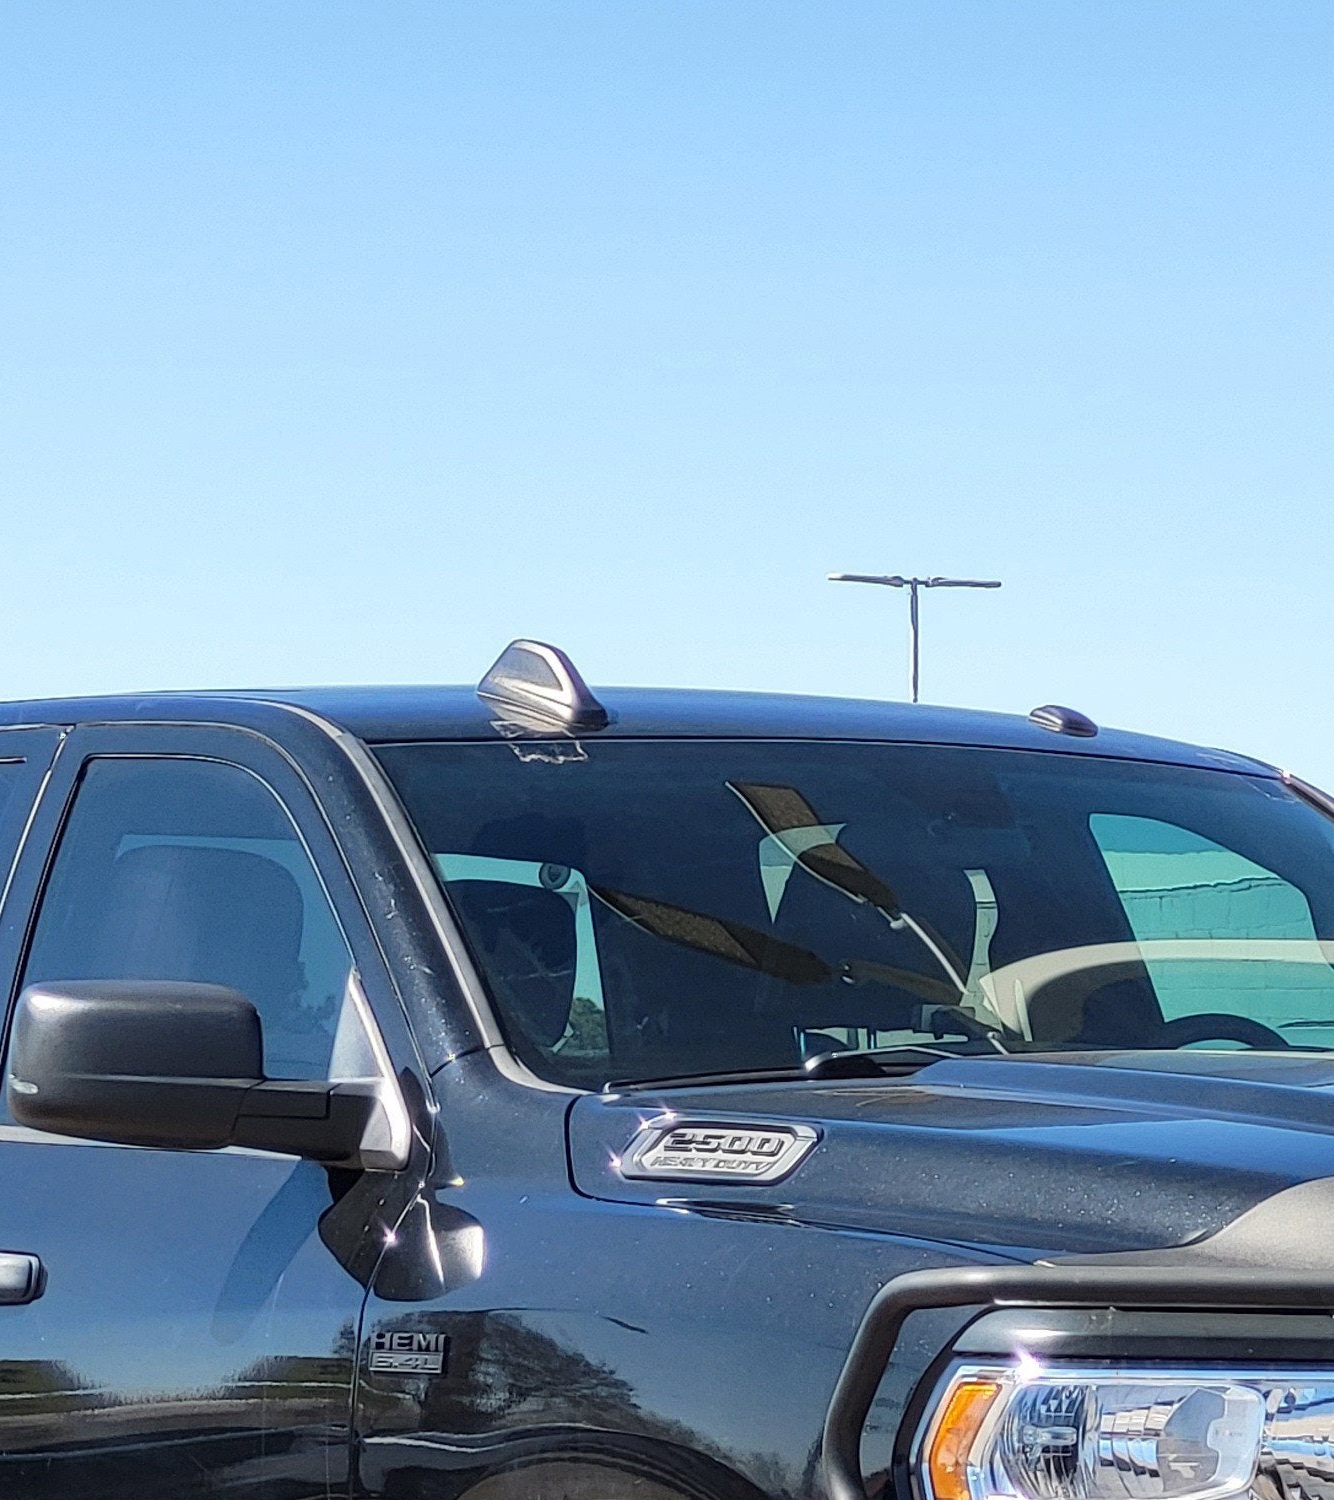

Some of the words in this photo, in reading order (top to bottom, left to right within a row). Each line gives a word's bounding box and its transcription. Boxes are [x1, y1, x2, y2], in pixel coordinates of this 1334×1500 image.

[663, 1132, 784, 1157] 2500
[650, 1155, 714, 1169] HEAVY
[716, 1158, 774, 1172] DUTY
[369, 1332, 447, 1352] HEMI
